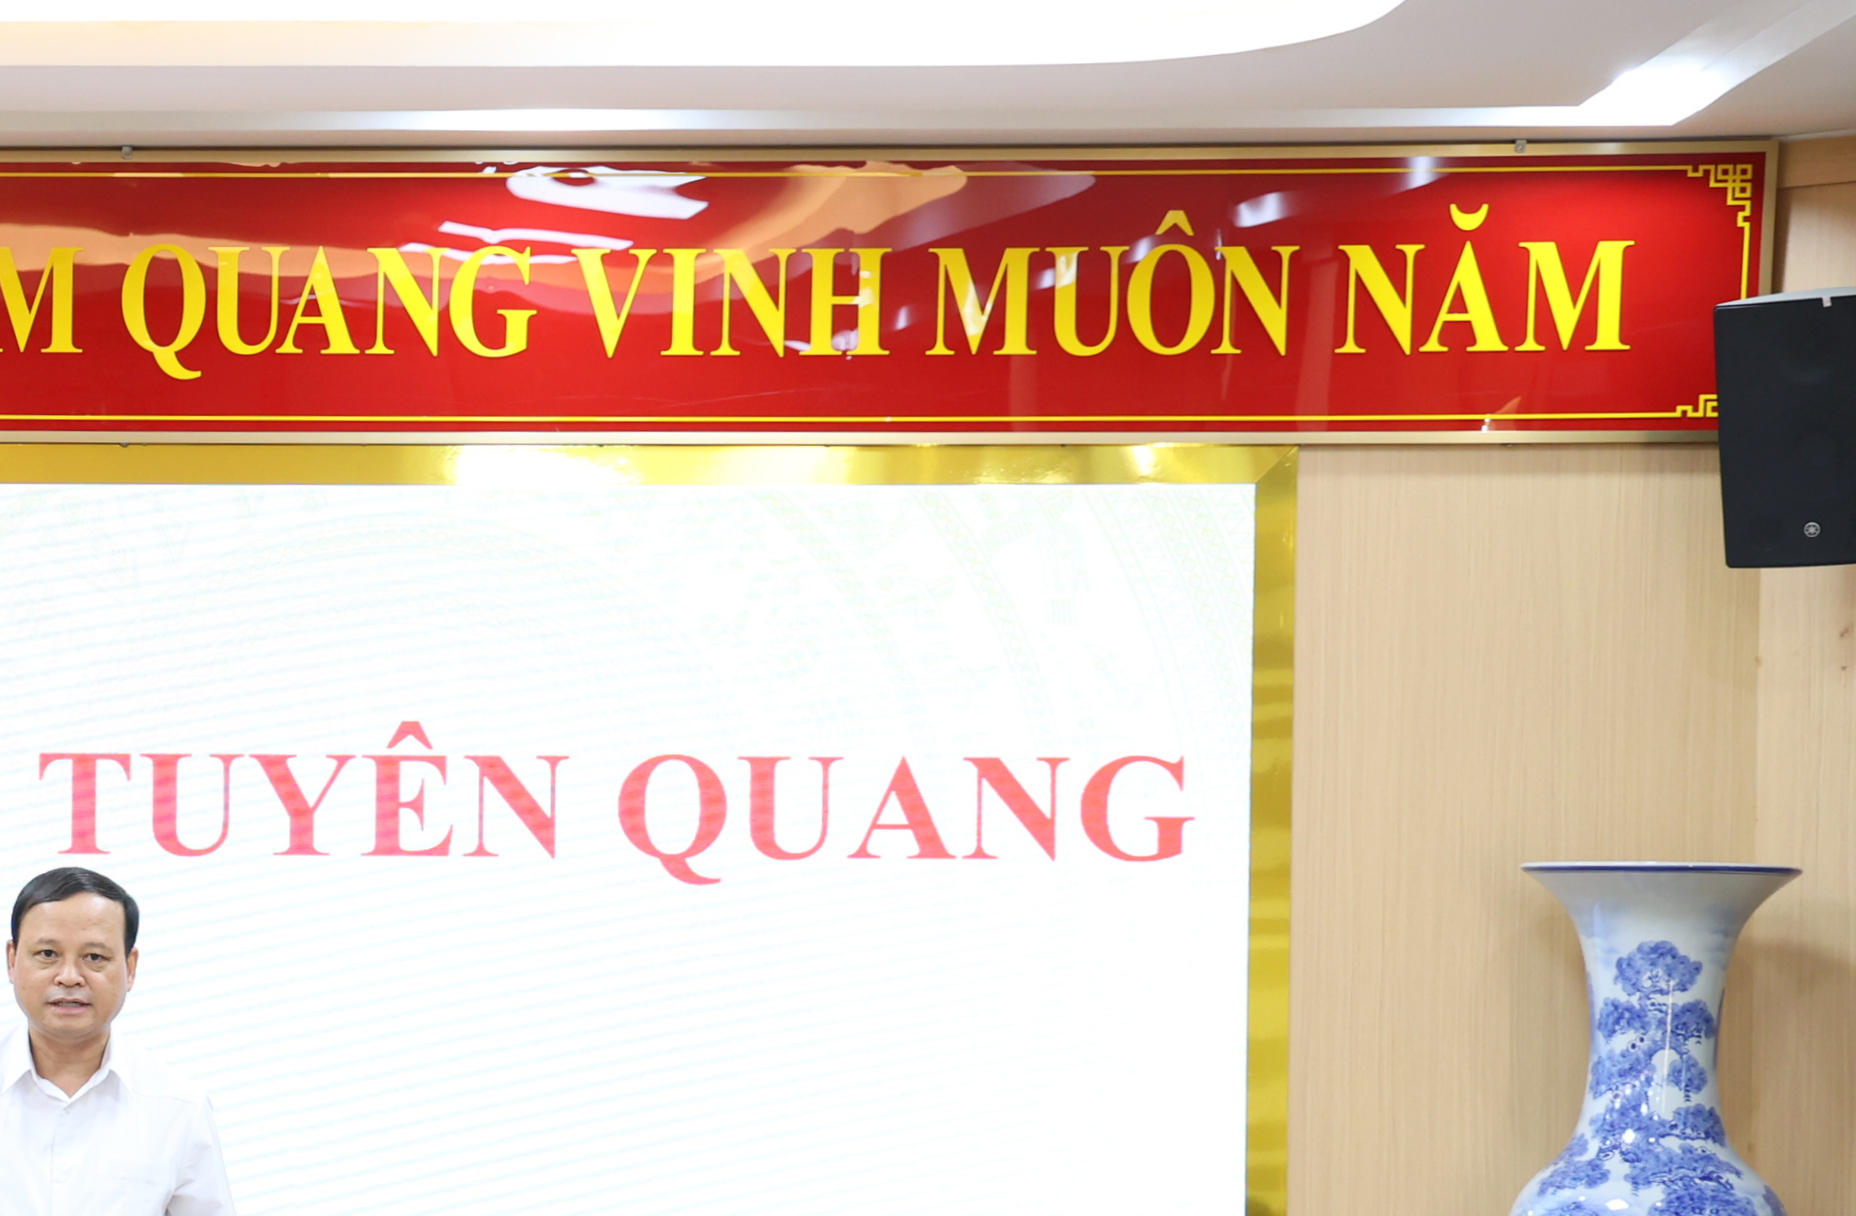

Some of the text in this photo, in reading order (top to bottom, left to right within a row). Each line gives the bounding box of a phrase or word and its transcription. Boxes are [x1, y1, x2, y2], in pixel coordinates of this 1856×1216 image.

[121, 242, 538, 381] QUANG
[574, 246, 892, 358] VINH
[924, 209, 1300, 358] MUÔN
[1334, 202, 1636, 356] NĂM
[39, 720, 569, 859] TUYÊN
[617, 753, 1196, 886] QUANG
